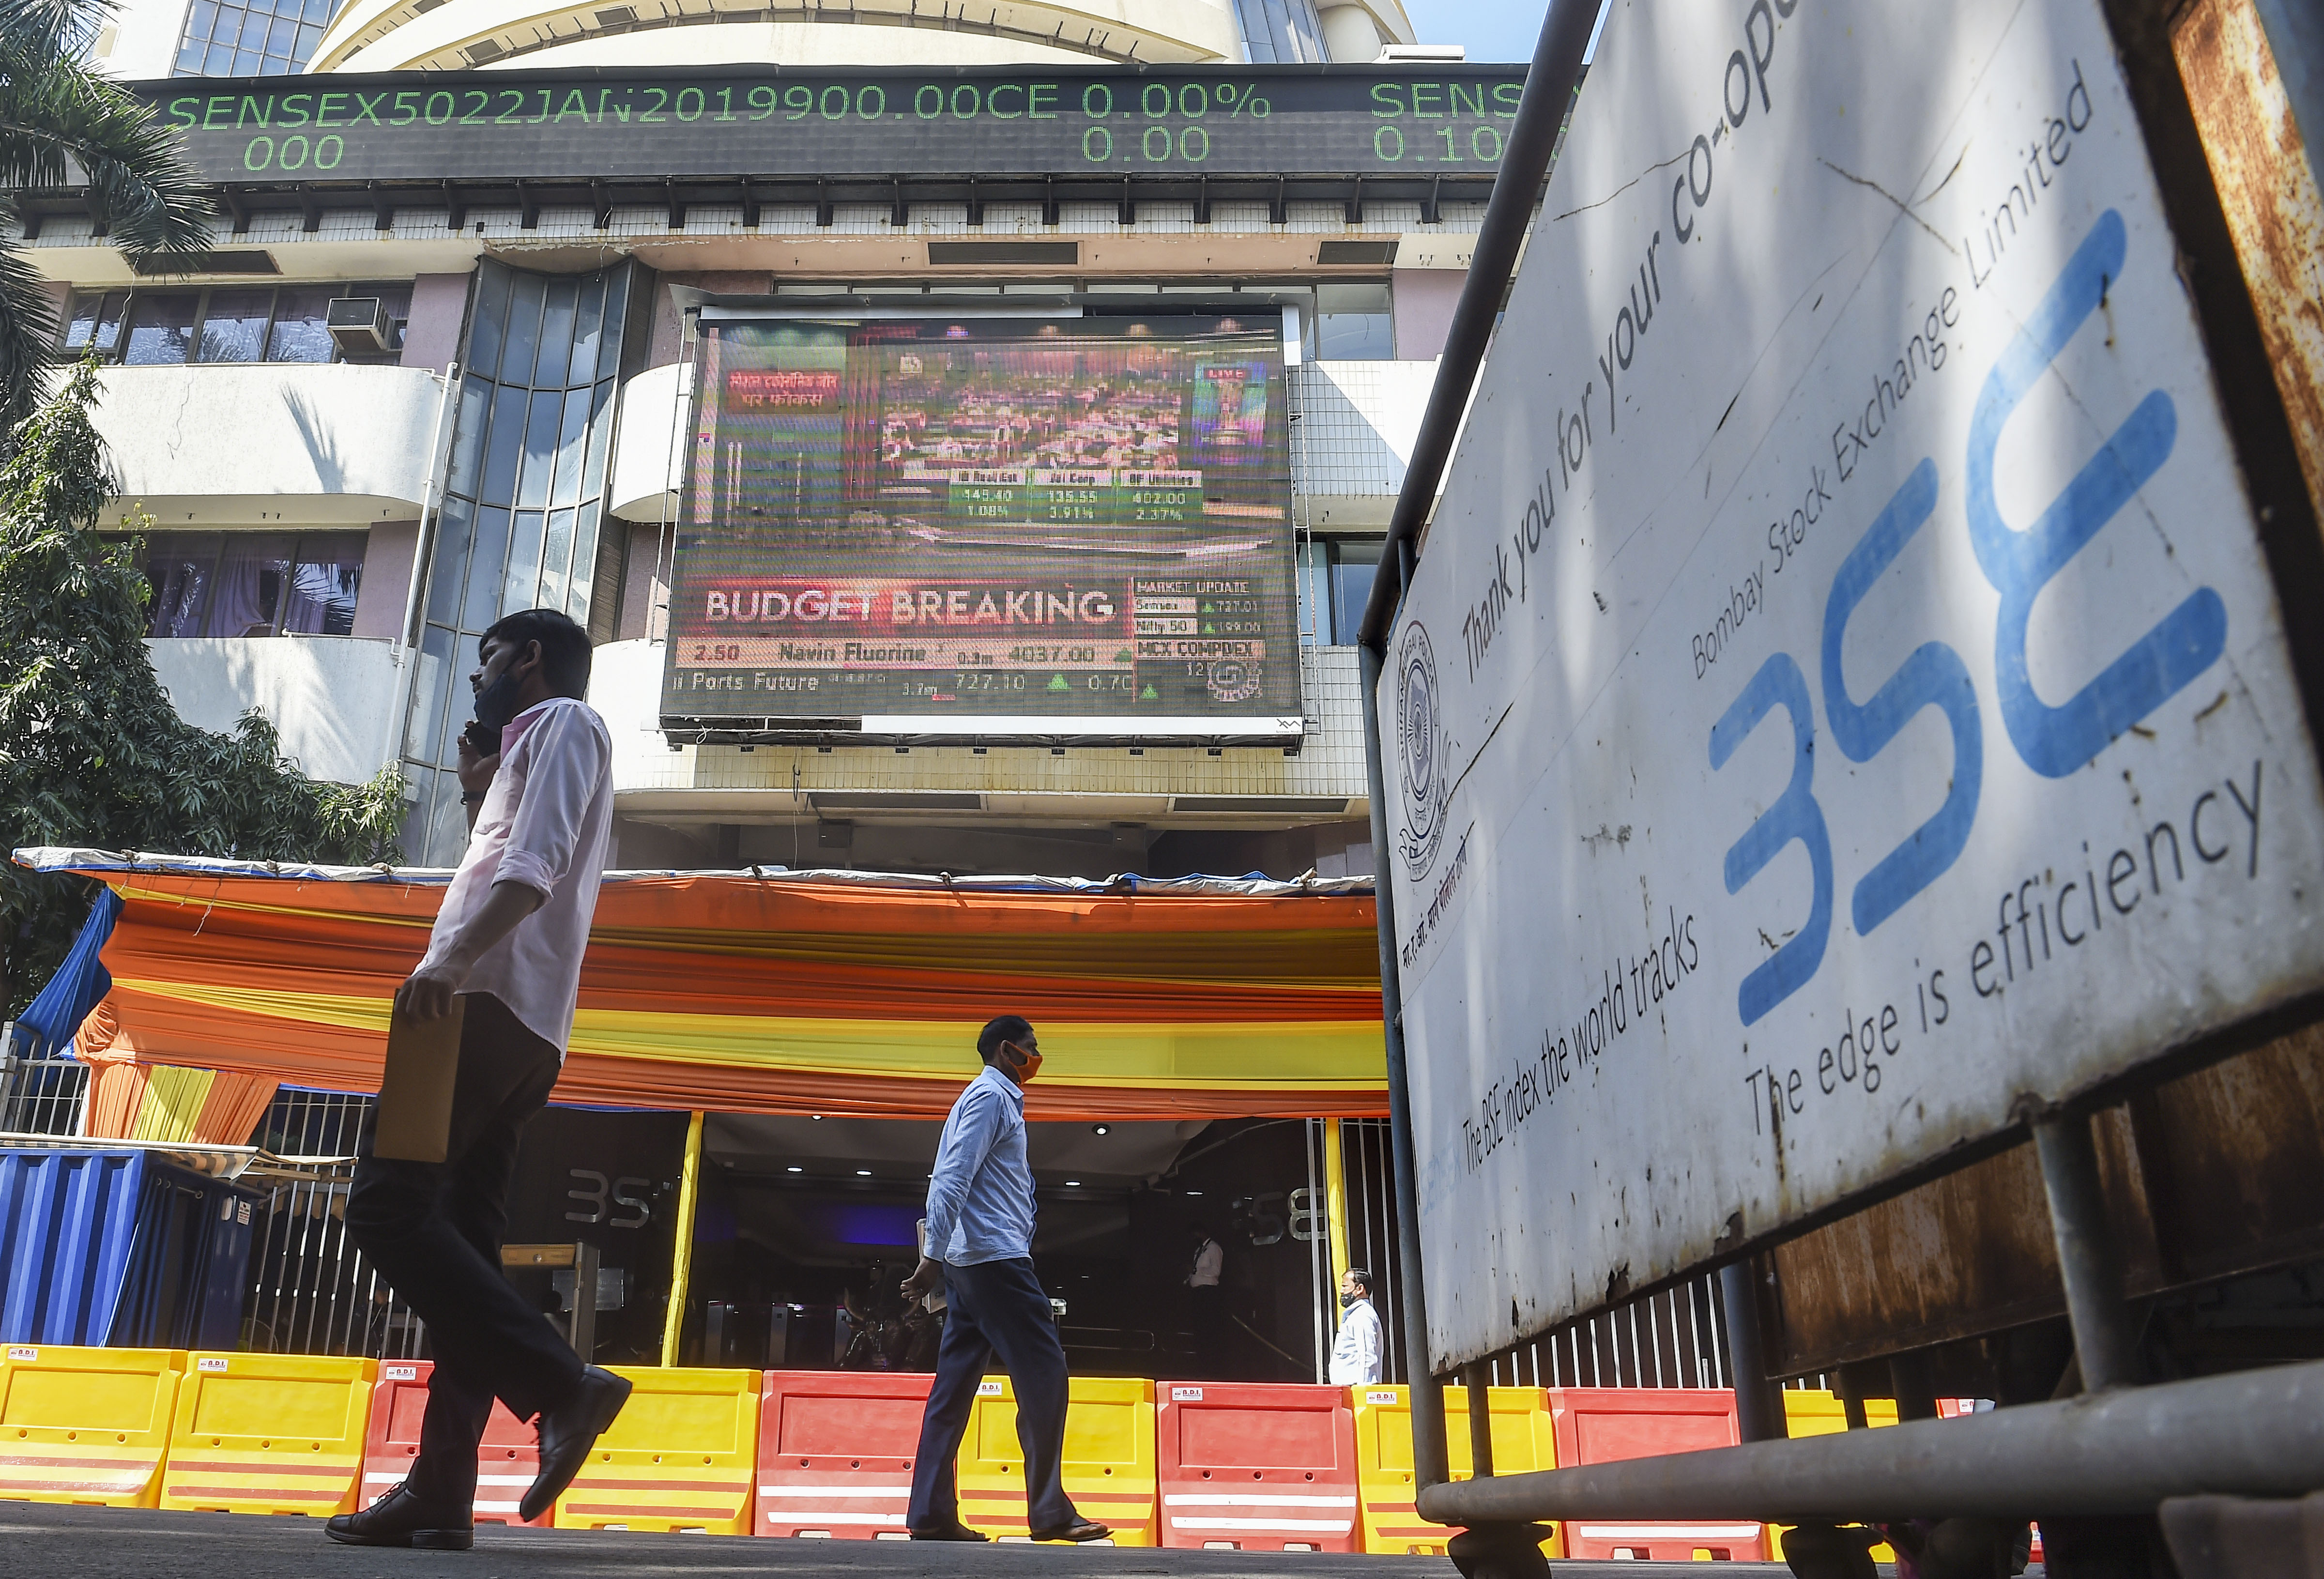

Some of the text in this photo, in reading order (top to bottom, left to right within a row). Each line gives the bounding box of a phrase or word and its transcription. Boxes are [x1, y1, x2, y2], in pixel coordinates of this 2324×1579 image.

[1083, 82, 1270, 119] 0.00%
[1370, 82, 1526, 119] SENS
[1083, 125, 1209, 162] 0.00
[1373, 125, 1503, 162] 0.10
[1208, 369, 1245, 378] LIVE
[1693, 58, 2094, 679] Bombay Stock Exchange Limited
[1463, 543, 1513, 684] Thank
[1514, 468, 1555, 604] you
[1557, 381, 1592, 491] for
[1599, 230, 1660, 436] your
[1137, 581, 1250, 594] MARKET UPDATE
[706, 589, 1116, 625] BUDGET BREAKING
[1170, 619, 1188, 631] 50
[694, 644, 740, 661] 2.50
[779, 643, 836, 662] Navin
[844, 643, 926, 662] Fluorine
[1138, 642, 1177, 657] MCX
[692, 672, 744, 690] Ports
[754, 672, 819, 691] Future
[954, 674, 1025, 690] 727.10
[1746, 759, 2262, 1135] The edge is efficiency
[1463, 905, 1698, 1175] The BSE index the world tracks
